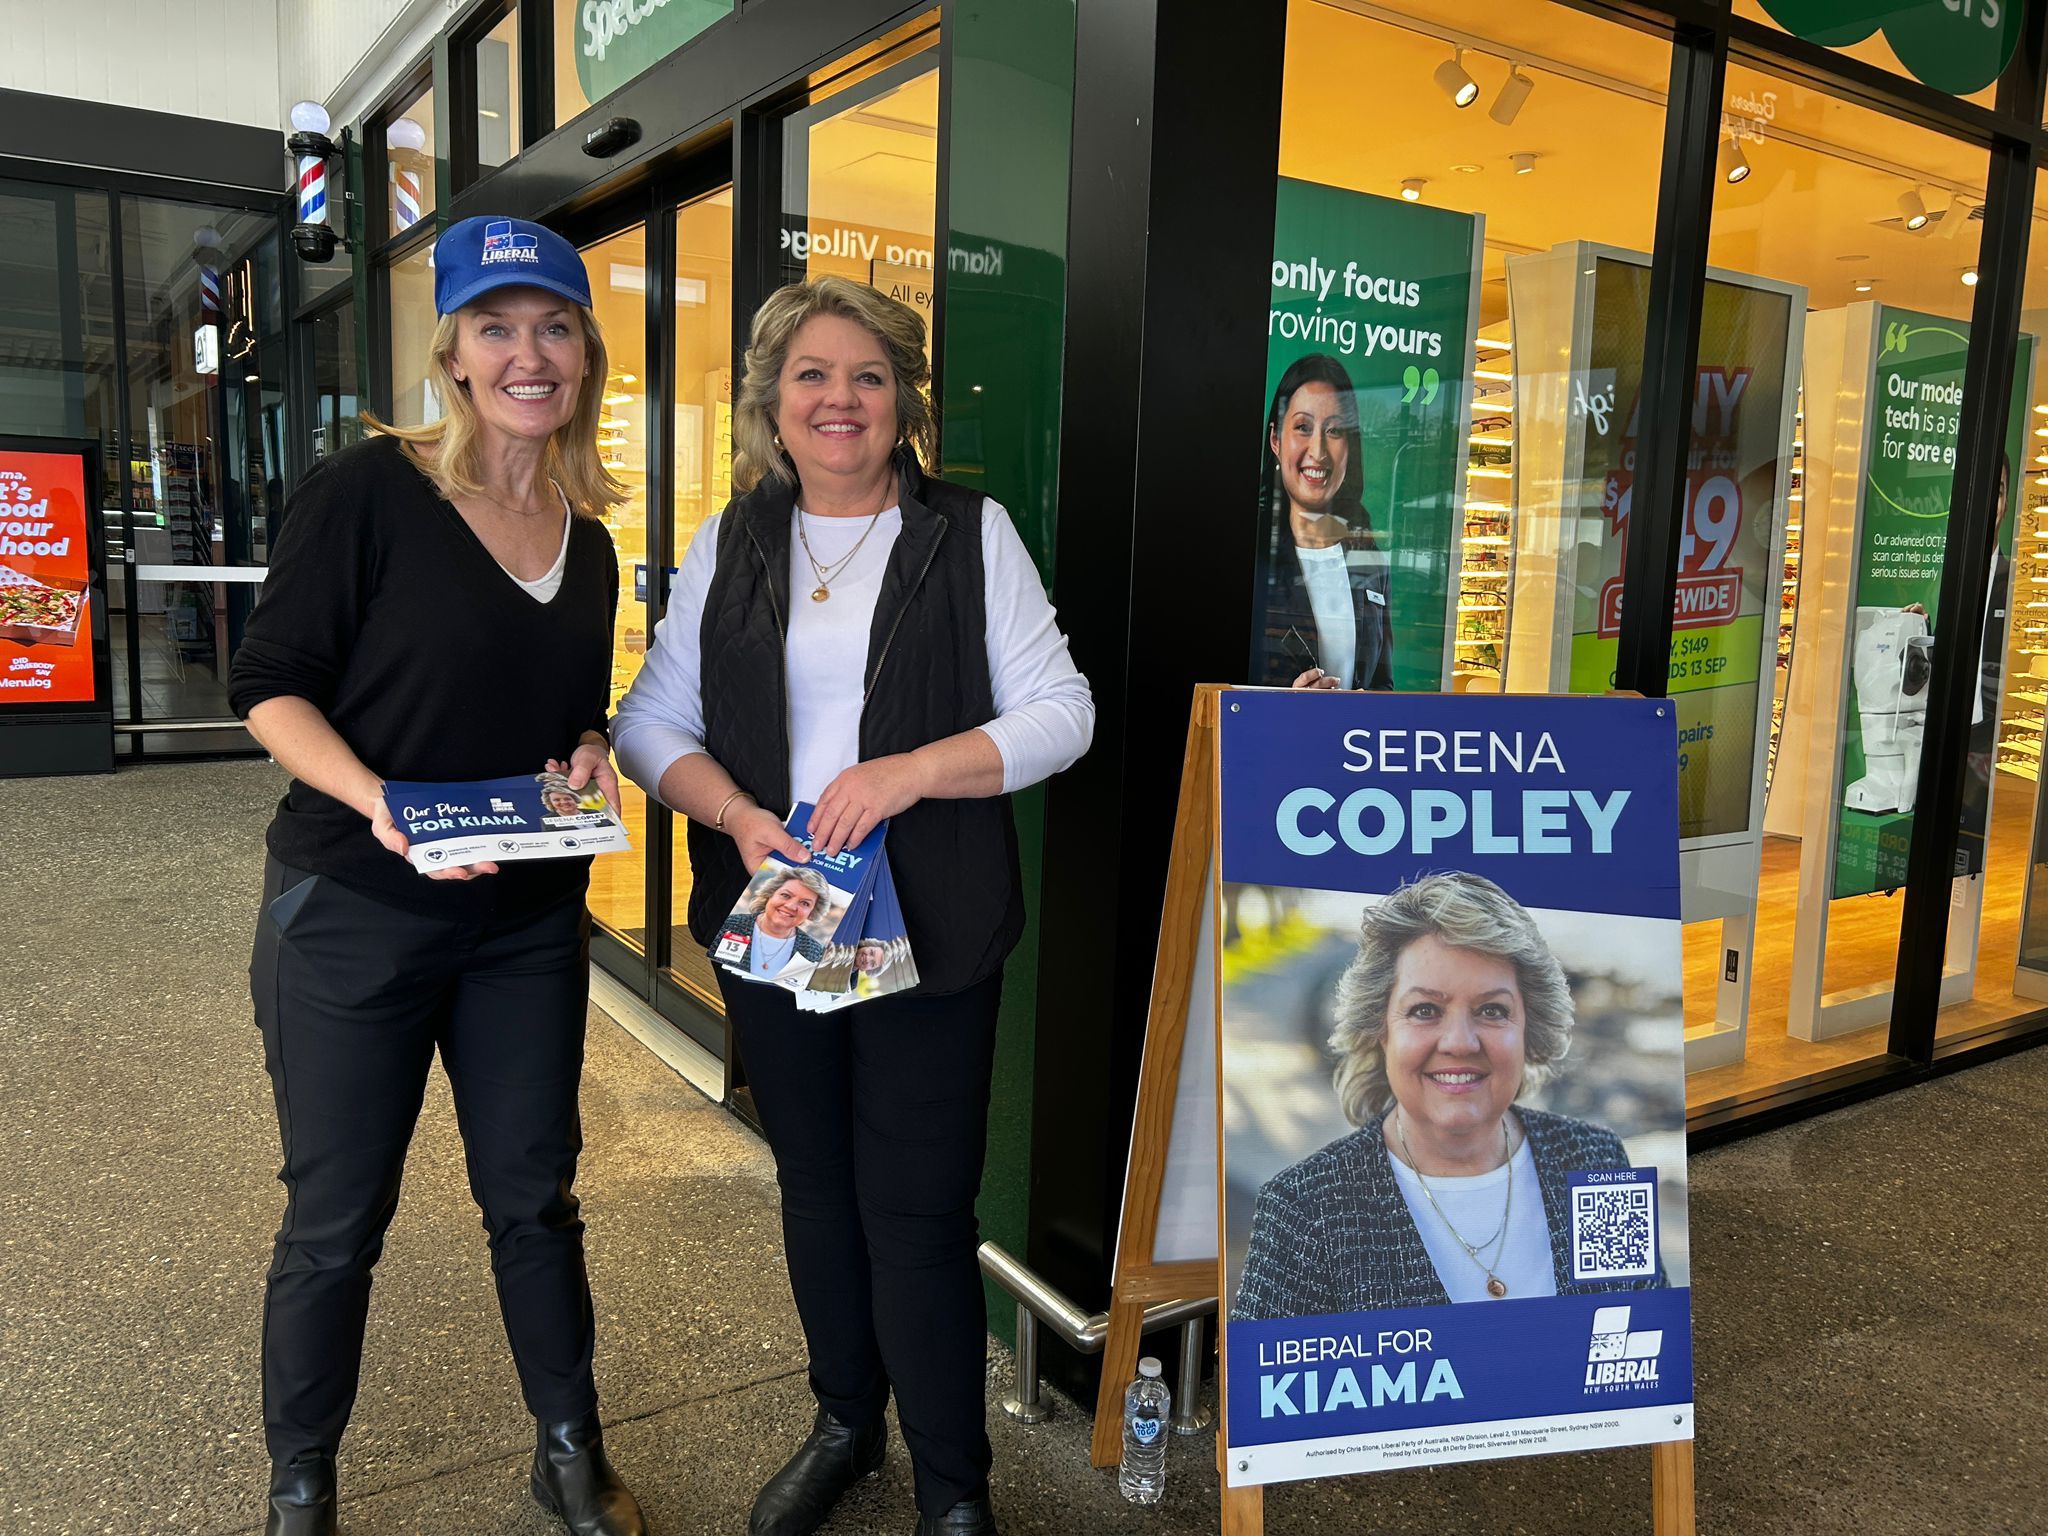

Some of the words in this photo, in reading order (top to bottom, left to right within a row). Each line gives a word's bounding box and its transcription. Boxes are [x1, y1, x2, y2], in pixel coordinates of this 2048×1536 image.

[482, 249, 539, 261] LIBERAL
[889, 284, 910, 302] All
[1343, 261, 1420, 307] focus
[1364, 323, 1442, 357] yours
[1887, 372, 1918, 399] Our
[1885, 405, 1919, 431] tech
[1923, 408, 1934, 433] is
[1936, 416, 1945, 434] a
[1882, 433, 1904, 459] for
[1907, 443, 1940, 463] sore
[1874, 533, 1889, 546] Our
[1890, 534, 1924, 547] advanced
[1925, 535, 1941, 548] OCT
[1872, 551, 1889, 563] scan
[1890, 552, 1904, 563] can
[1905, 550, 1921, 566] help
[1922, 551, 1930, 563] us
[1871, 565, 1897, 579] serious
[1898, 566, 1920, 579] issues
[1921, 568, 1938, 582] early
[1681, 636, 1709, 657] $149
[9, 662, 55, 671] SOMEBODY
[12, 657, 29, 665] DID
[1691, 659, 1702, 676] 13
[1705, 656, 1727, 674] SEP
[1679, 720, 1714, 750] pairs
[1342, 729, 1566, 774] SERENA
[402, 806, 430, 821] Our
[437, 803, 470, 815] Plan
[1275, 787, 1632, 856] COPLEY
[408, 818, 454, 834] FOR
[460, 815, 528, 827] KIAMA
[812, 859, 824, 867] FOR
[823, 862, 844, 873] KIAMA
[726, 941, 740, 952] 13
[1587, 1173, 1613, 1182] SCAN
[1614, 1171, 1637, 1180] HERE
[1259, 1336, 1371, 1366] LIBERAL
[1378, 1328, 1433, 1355] FOR
[1584, 1359, 1660, 1386] LIBERAL
[1260, 1358, 1465, 1418] KIAMA
[1583, 1386, 1600, 1394] NEW
[1604, 1383, 1630, 1392] SOUTH
[1634, 1381, 1659, 1390] WALES
[1135, 1421, 1156, 1430] AQUA
[1306, 1449, 1337, 1457] Authorised
[1381, 1441, 1401, 1450] Liberal
[1401, 1440, 1416, 1448] Party
[1424, 1436, 1450, 1445] Australia,
[1466, 1433, 1489, 1441] Division,
[1489, 1430, 1504, 1438] Level
[1520, 1427, 1549, 1436] Macquarie
[1569, 1424, 1589, 1432] Sydney
[1422, 1447, 1441, 1455] Group,
[1450, 1444, 1467, 1452] Derby
[1467, 1441, 1486, 1450] Street,
[1487, 1439, 1517, 1448] Silverwater
[1518, 1438, 1532, 1446] NSW
